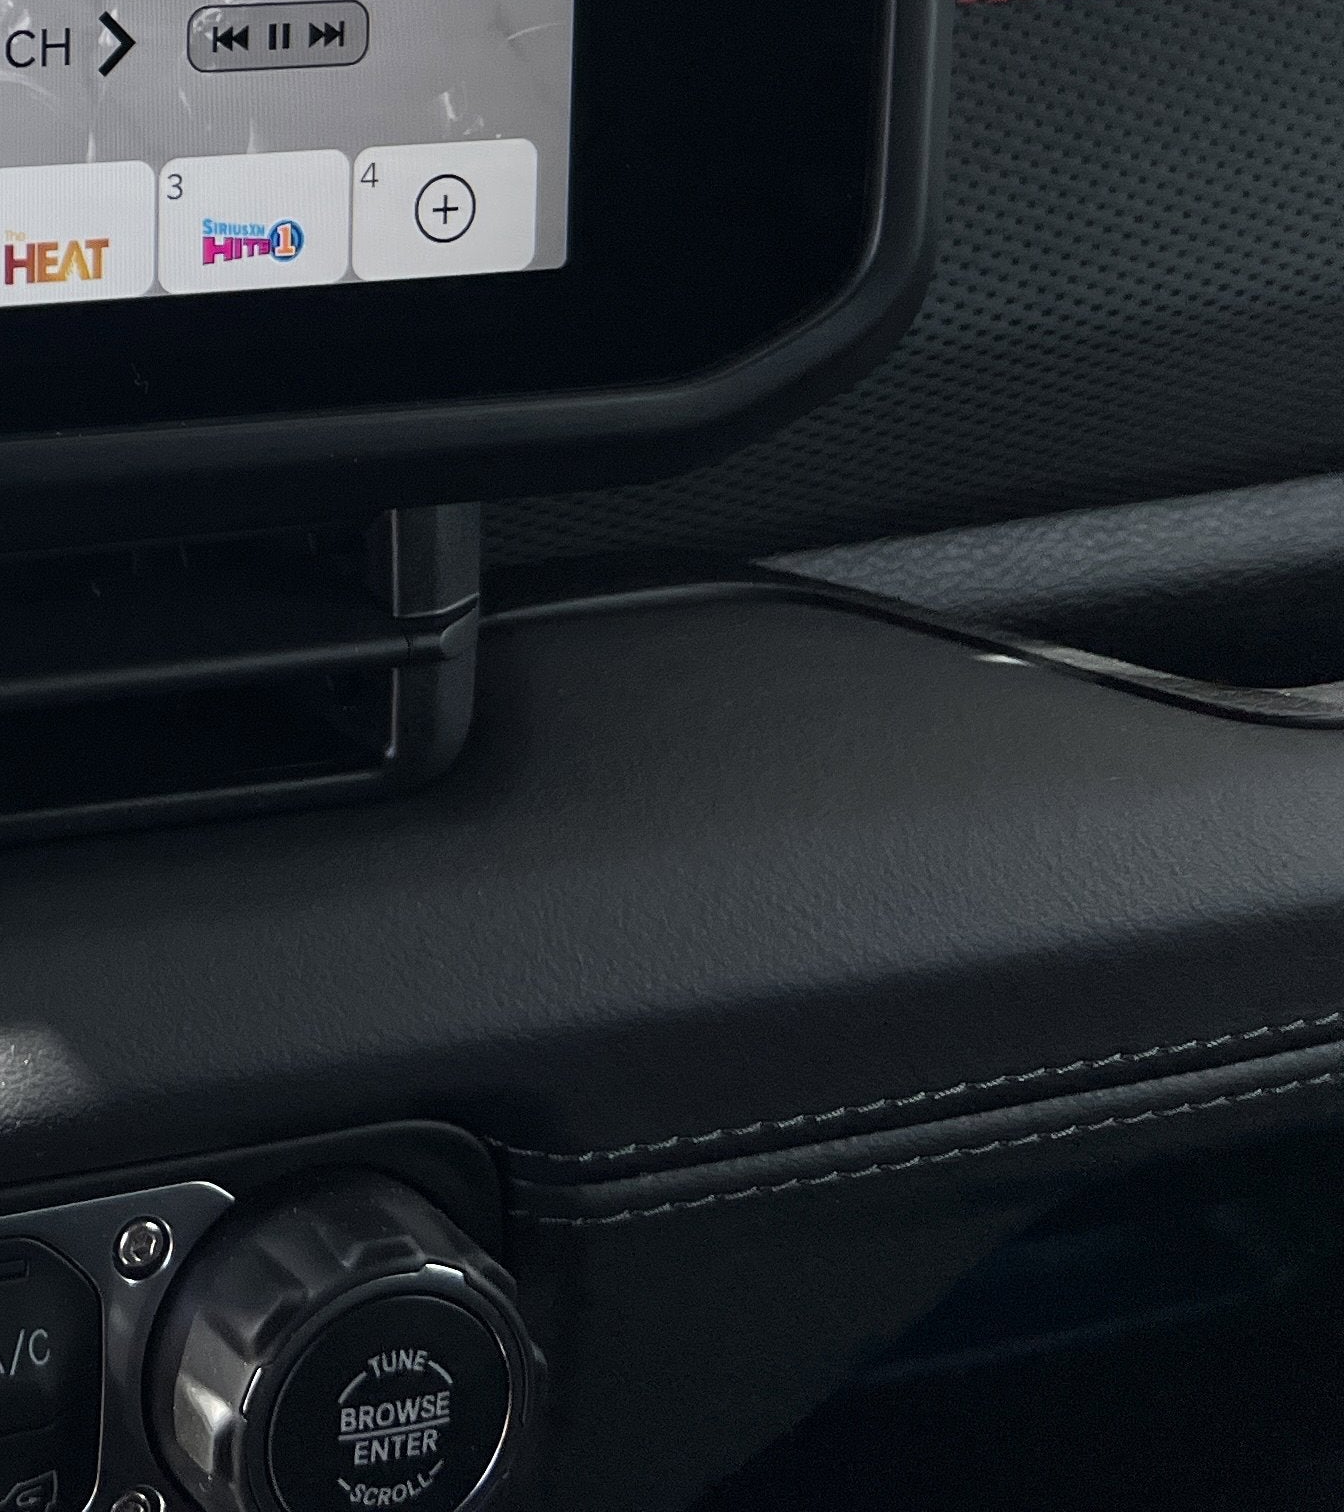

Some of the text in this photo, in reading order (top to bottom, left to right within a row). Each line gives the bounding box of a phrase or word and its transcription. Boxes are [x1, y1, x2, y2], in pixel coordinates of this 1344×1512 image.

[5, 27, 71, 69] CH
[166, 173, 183, 200] 3
[360, 162, 379, 188] 4
[4, 238, 110, 285] HEAT
[202, 223, 296, 266] HITS 1
[368, 1348, 428, 1378] TUNE
[340, 1391, 450, 1433] BROWSE
[353, 1429, 439, 1466] ENTER
[349, 1471, 432, 1507] SCROLL
